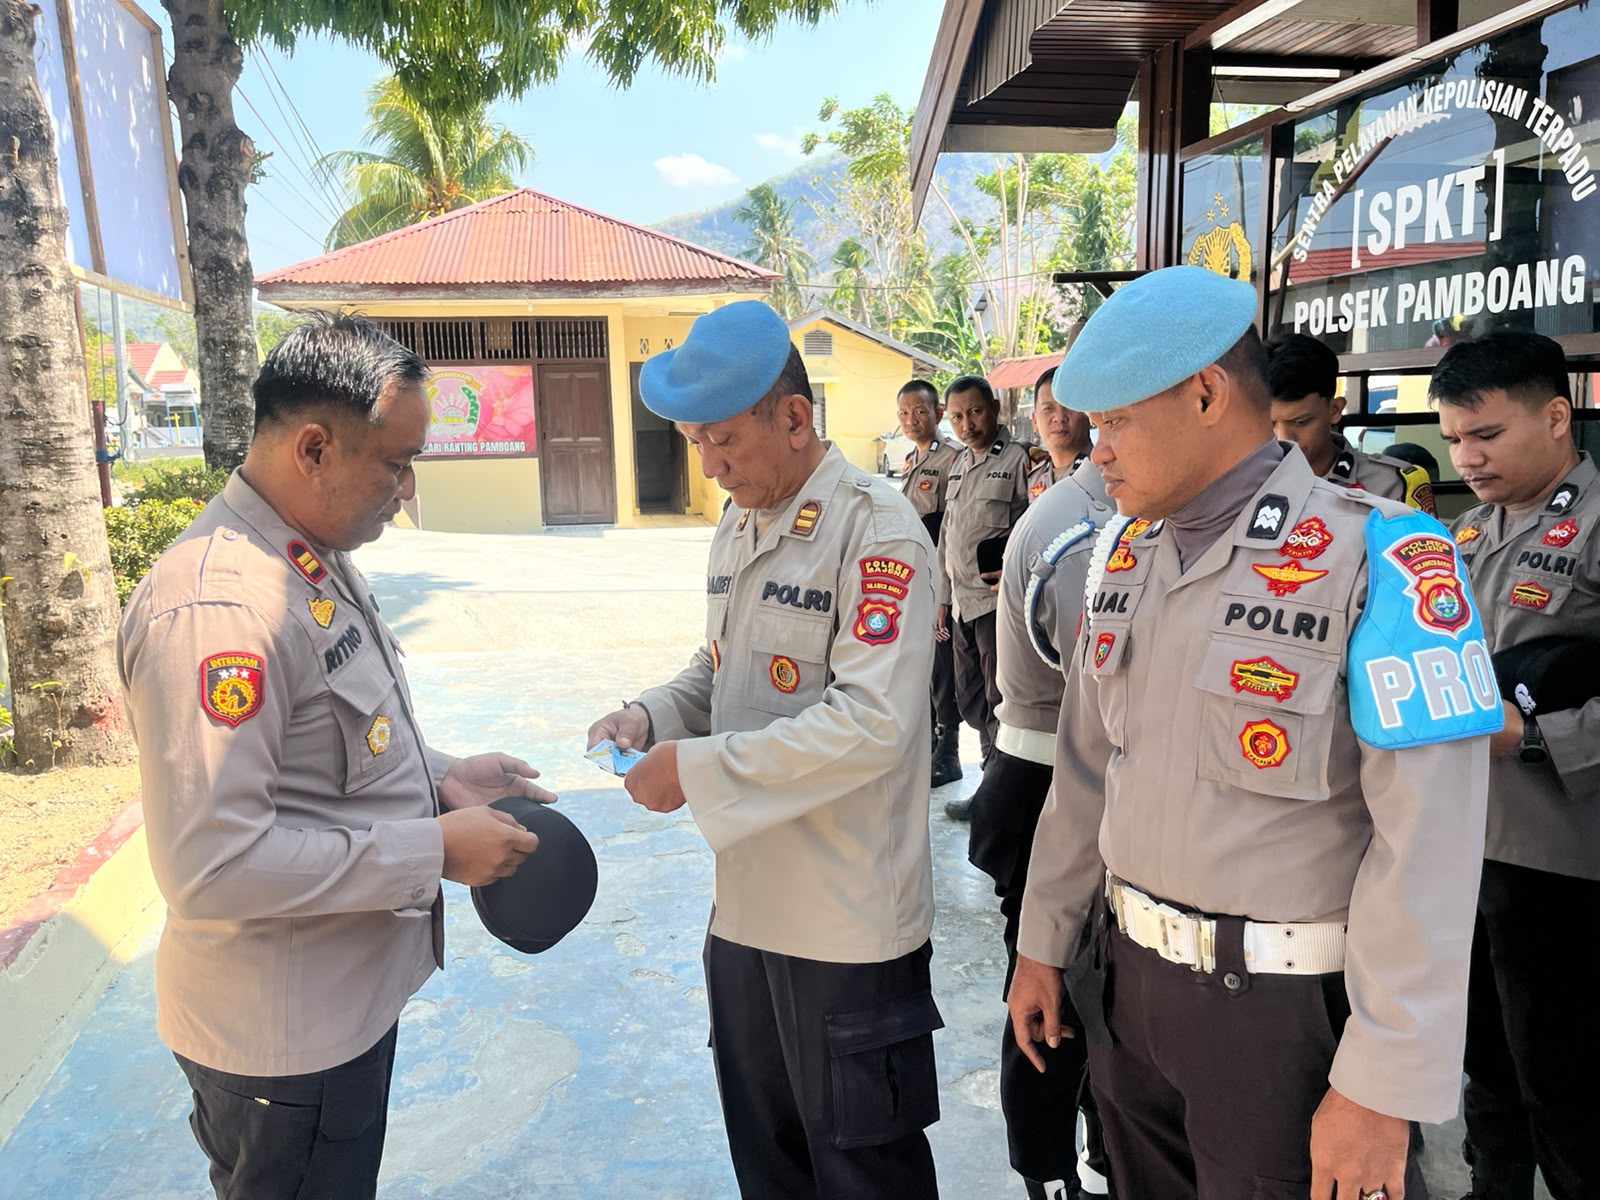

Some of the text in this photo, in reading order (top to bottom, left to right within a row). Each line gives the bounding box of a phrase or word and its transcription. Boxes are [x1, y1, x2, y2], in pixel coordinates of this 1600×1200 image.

[1293, 78, 1597, 263] SENTRA PELAYANAN KEPOLISIAN TERPADU
[1294, 254, 1586, 336] POLSEK PAMBOANG
[426, 441, 526, 453] ARI RANTING PAMBOANG
[920, 468, 940, 477] POLRI
[986, 471, 1012, 480] POLRI
[1517, 551, 1577, 576] POLRI
[762, 581, 832, 613] POLRI
[1224, 602, 1330, 642] POLRI
[209, 656, 258, 668] INTELKAM
[1365, 637, 1502, 729] PRO
